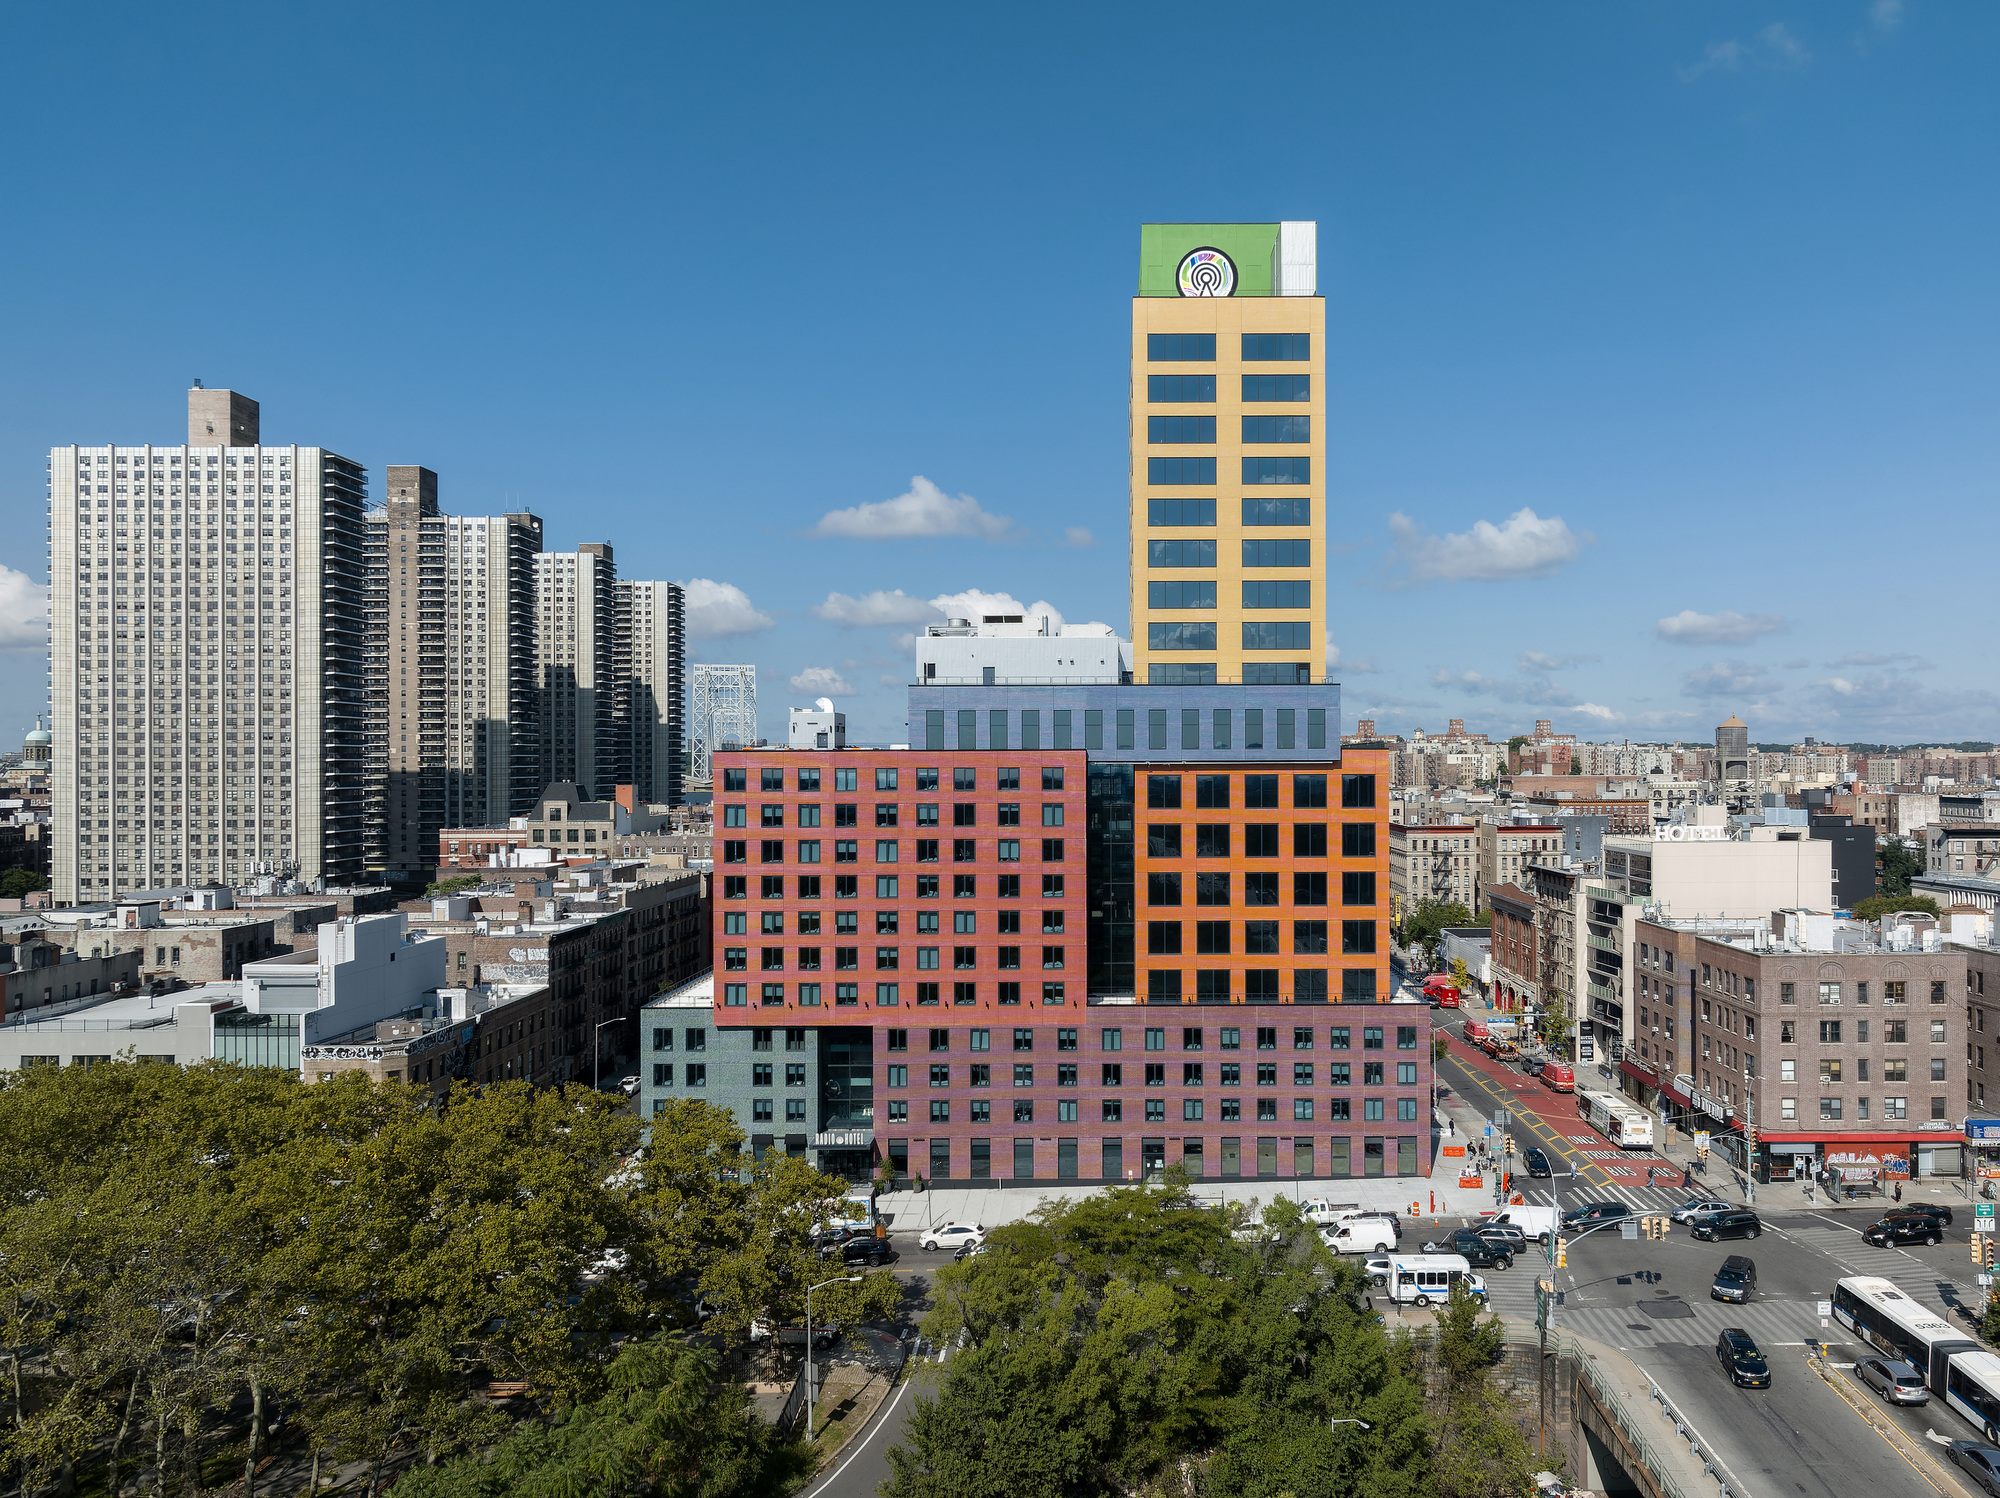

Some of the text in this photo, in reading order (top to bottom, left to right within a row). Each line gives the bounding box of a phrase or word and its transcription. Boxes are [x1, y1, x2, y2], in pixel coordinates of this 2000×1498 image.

[1654, 825, 1730, 841] HOTEL
[815, 1133, 864, 1145] RADIO HOTEL
[1567, 1135, 1599, 1145] ONLY
[1581, 1150, 1623, 1160] TRUCK
[1604, 1166, 1637, 1176] BUS
